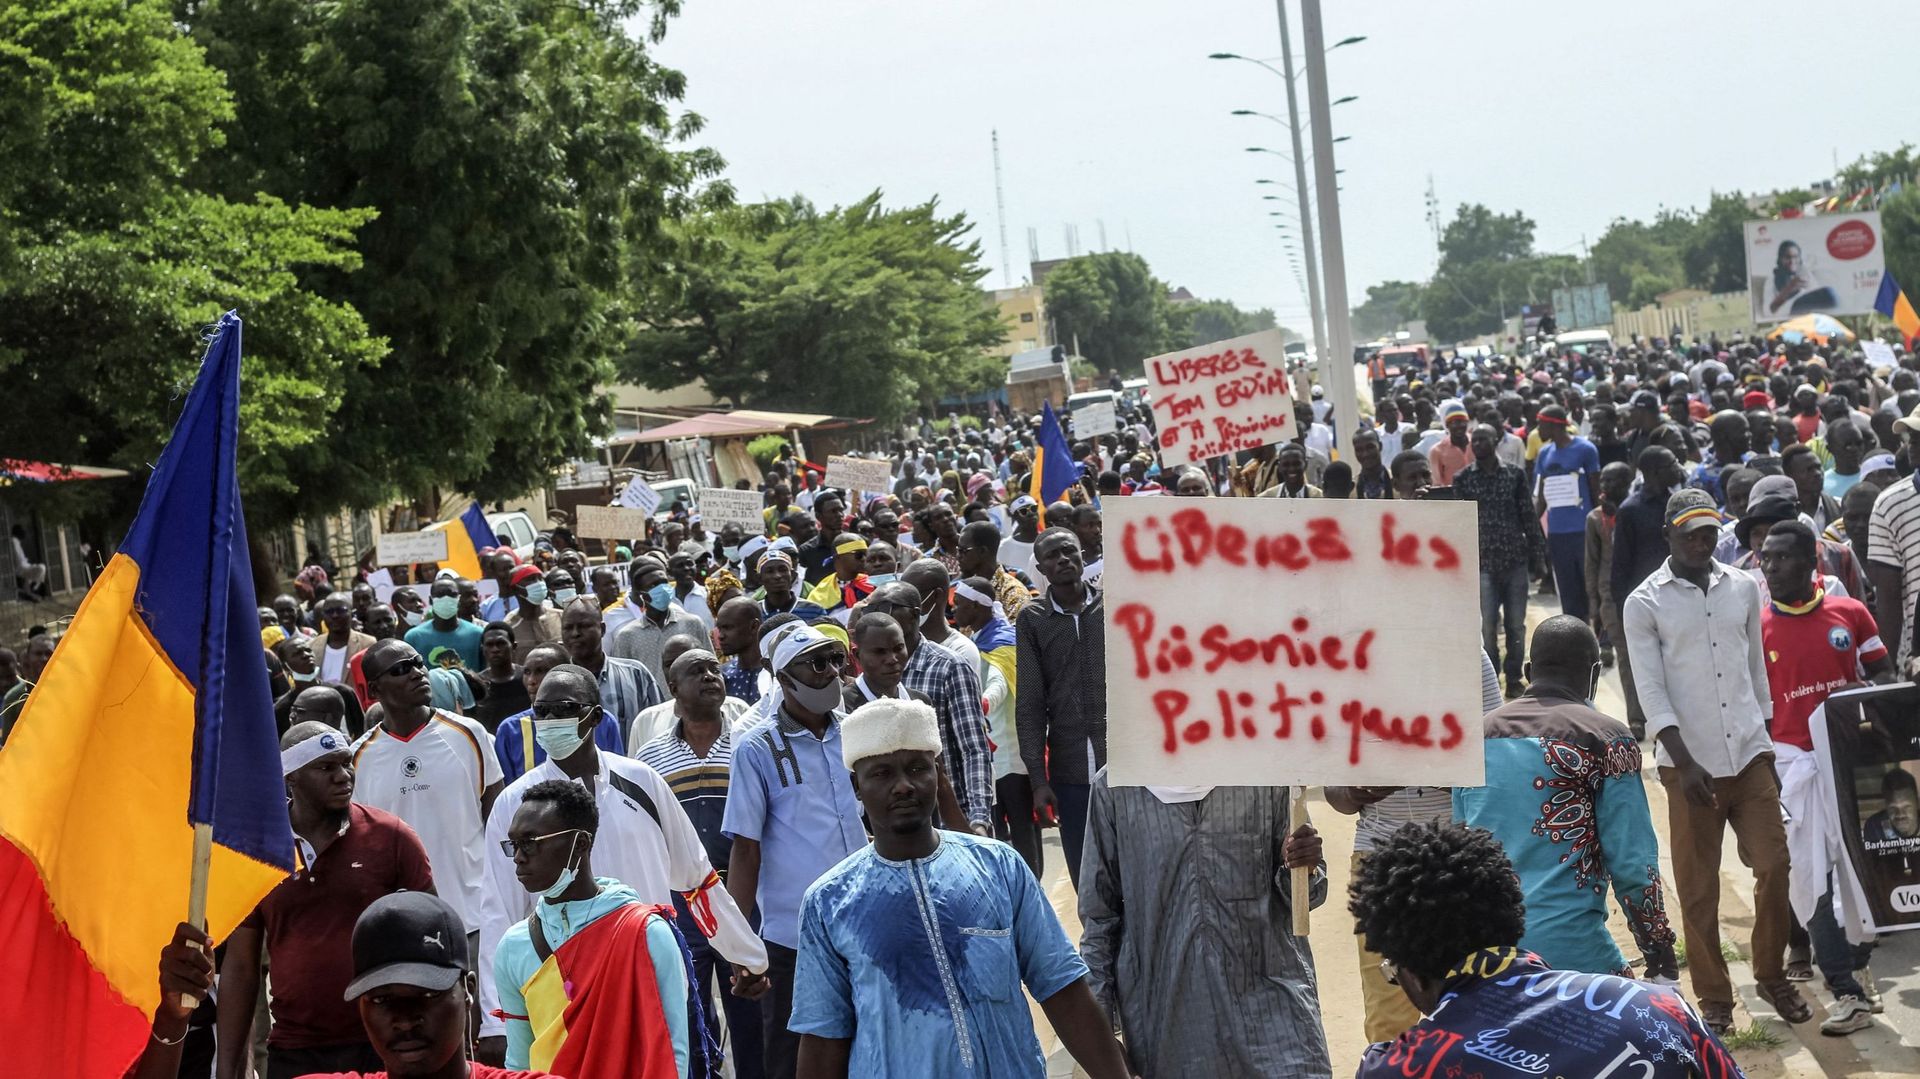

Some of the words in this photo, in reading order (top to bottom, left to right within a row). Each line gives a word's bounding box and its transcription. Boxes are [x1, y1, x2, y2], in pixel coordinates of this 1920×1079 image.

[1790, 684, 1816, 699] colère
[1815, 681, 1826, 692] du
[1464, 1028, 1549, 1073] Gucci
